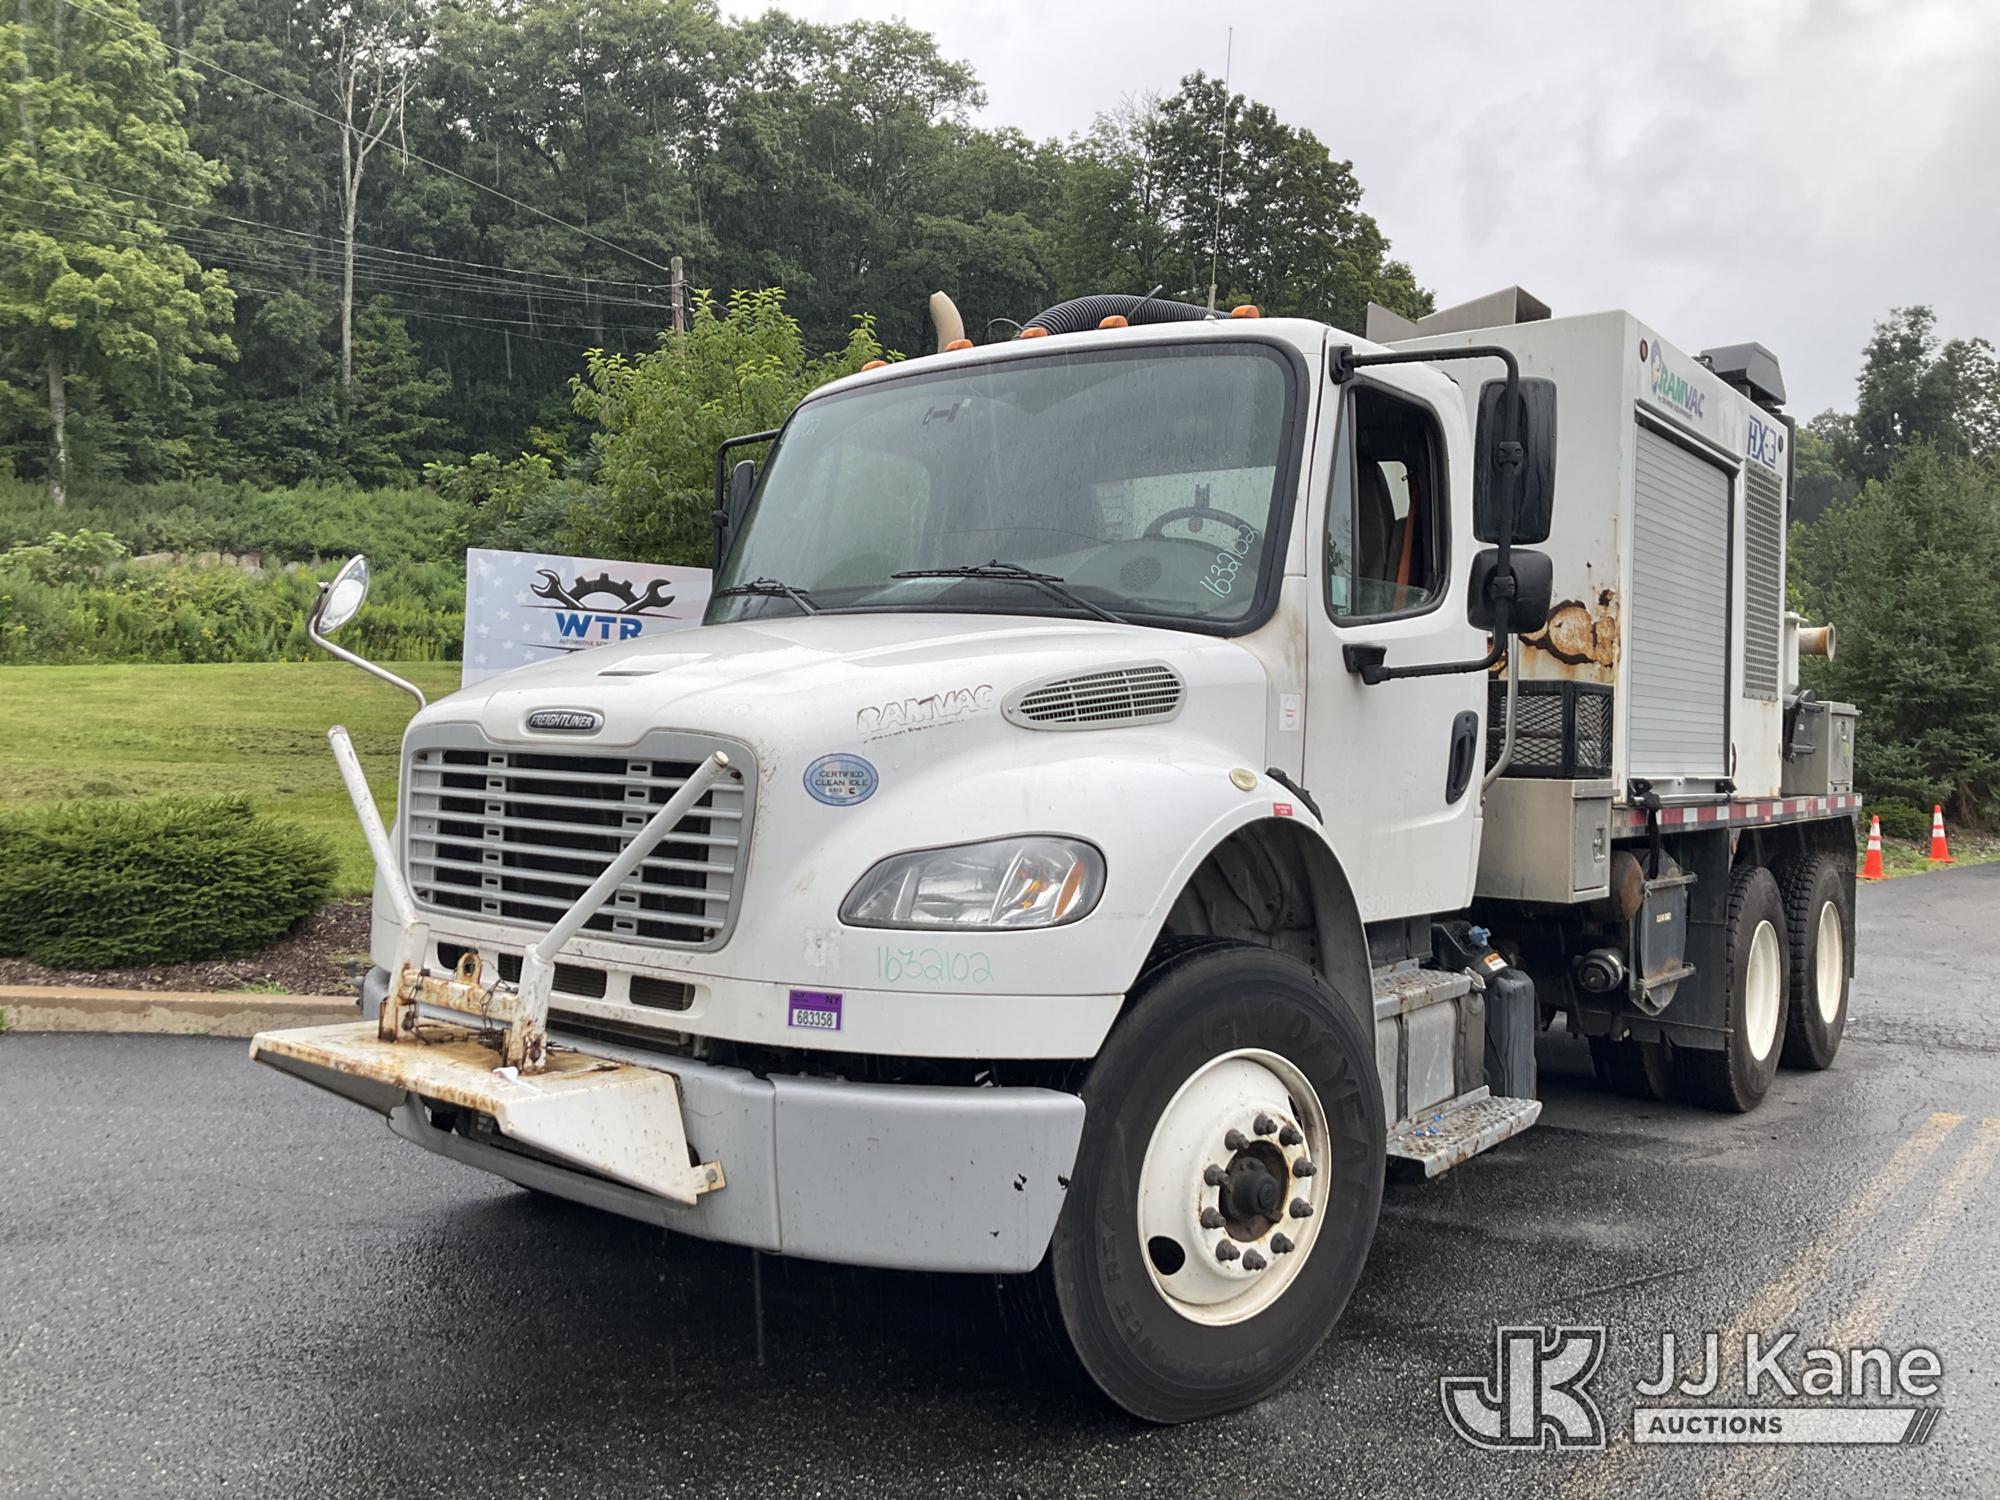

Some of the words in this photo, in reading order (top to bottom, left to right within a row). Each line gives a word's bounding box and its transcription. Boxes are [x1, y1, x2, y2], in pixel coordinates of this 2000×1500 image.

[1200, 524, 1260, 598] 1632102
[555, 612, 643, 641] WTR
[530, 713, 594, 728] FREIGHTLINER
[819, 770, 864, 778] CERTIFIED
[815, 779, 846, 787] CLEAN
[848, 779, 869, 787] IDLE
[825, 994, 841, 1005] NY
[796, 1010, 833, 1027] 683358
